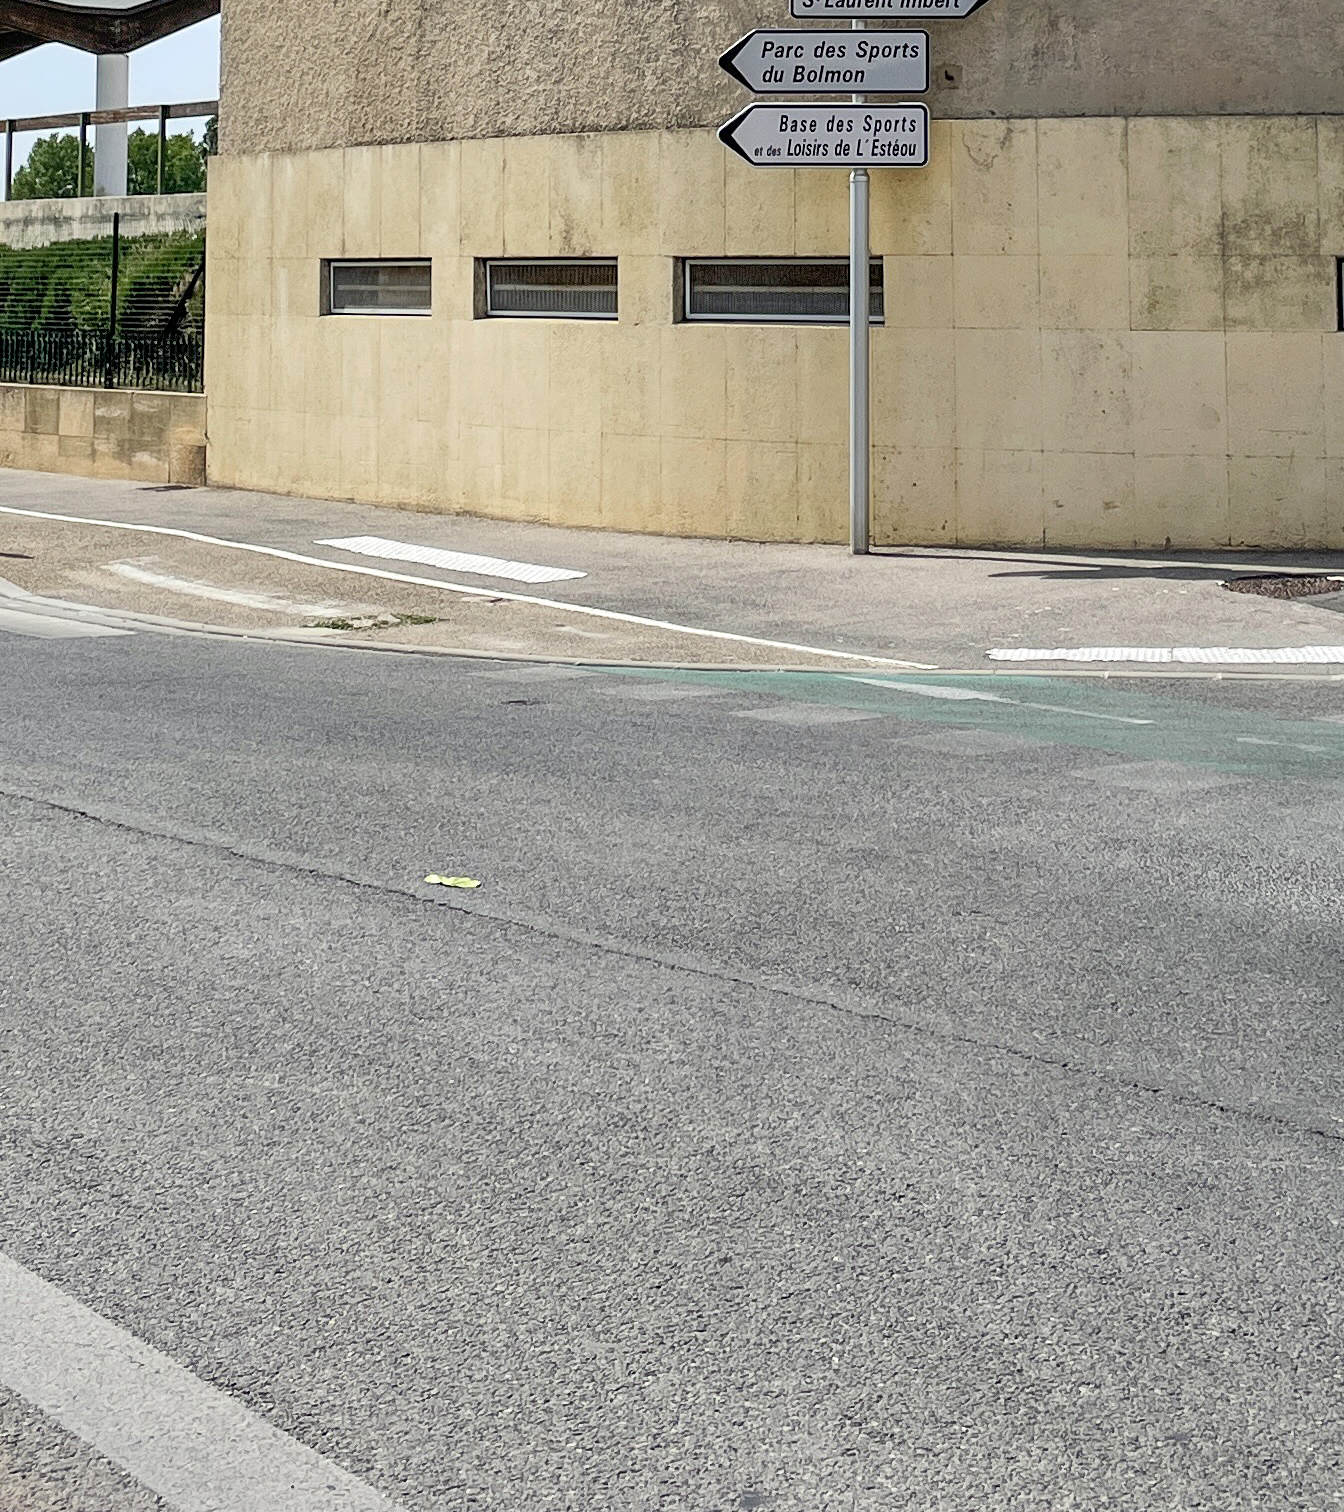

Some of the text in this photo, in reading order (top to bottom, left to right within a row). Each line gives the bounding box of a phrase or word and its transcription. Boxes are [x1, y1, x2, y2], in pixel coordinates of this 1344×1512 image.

[761, 41, 919, 63] Parc des Sports
[762, 66, 865, 83] du Bolmon
[779, 115, 917, 136] Base des Sports
[754, 146, 764, 157] et
[766, 145, 782, 157] des
[786, 139, 829, 157] Loisirs
[834, 139, 850, 157] de
